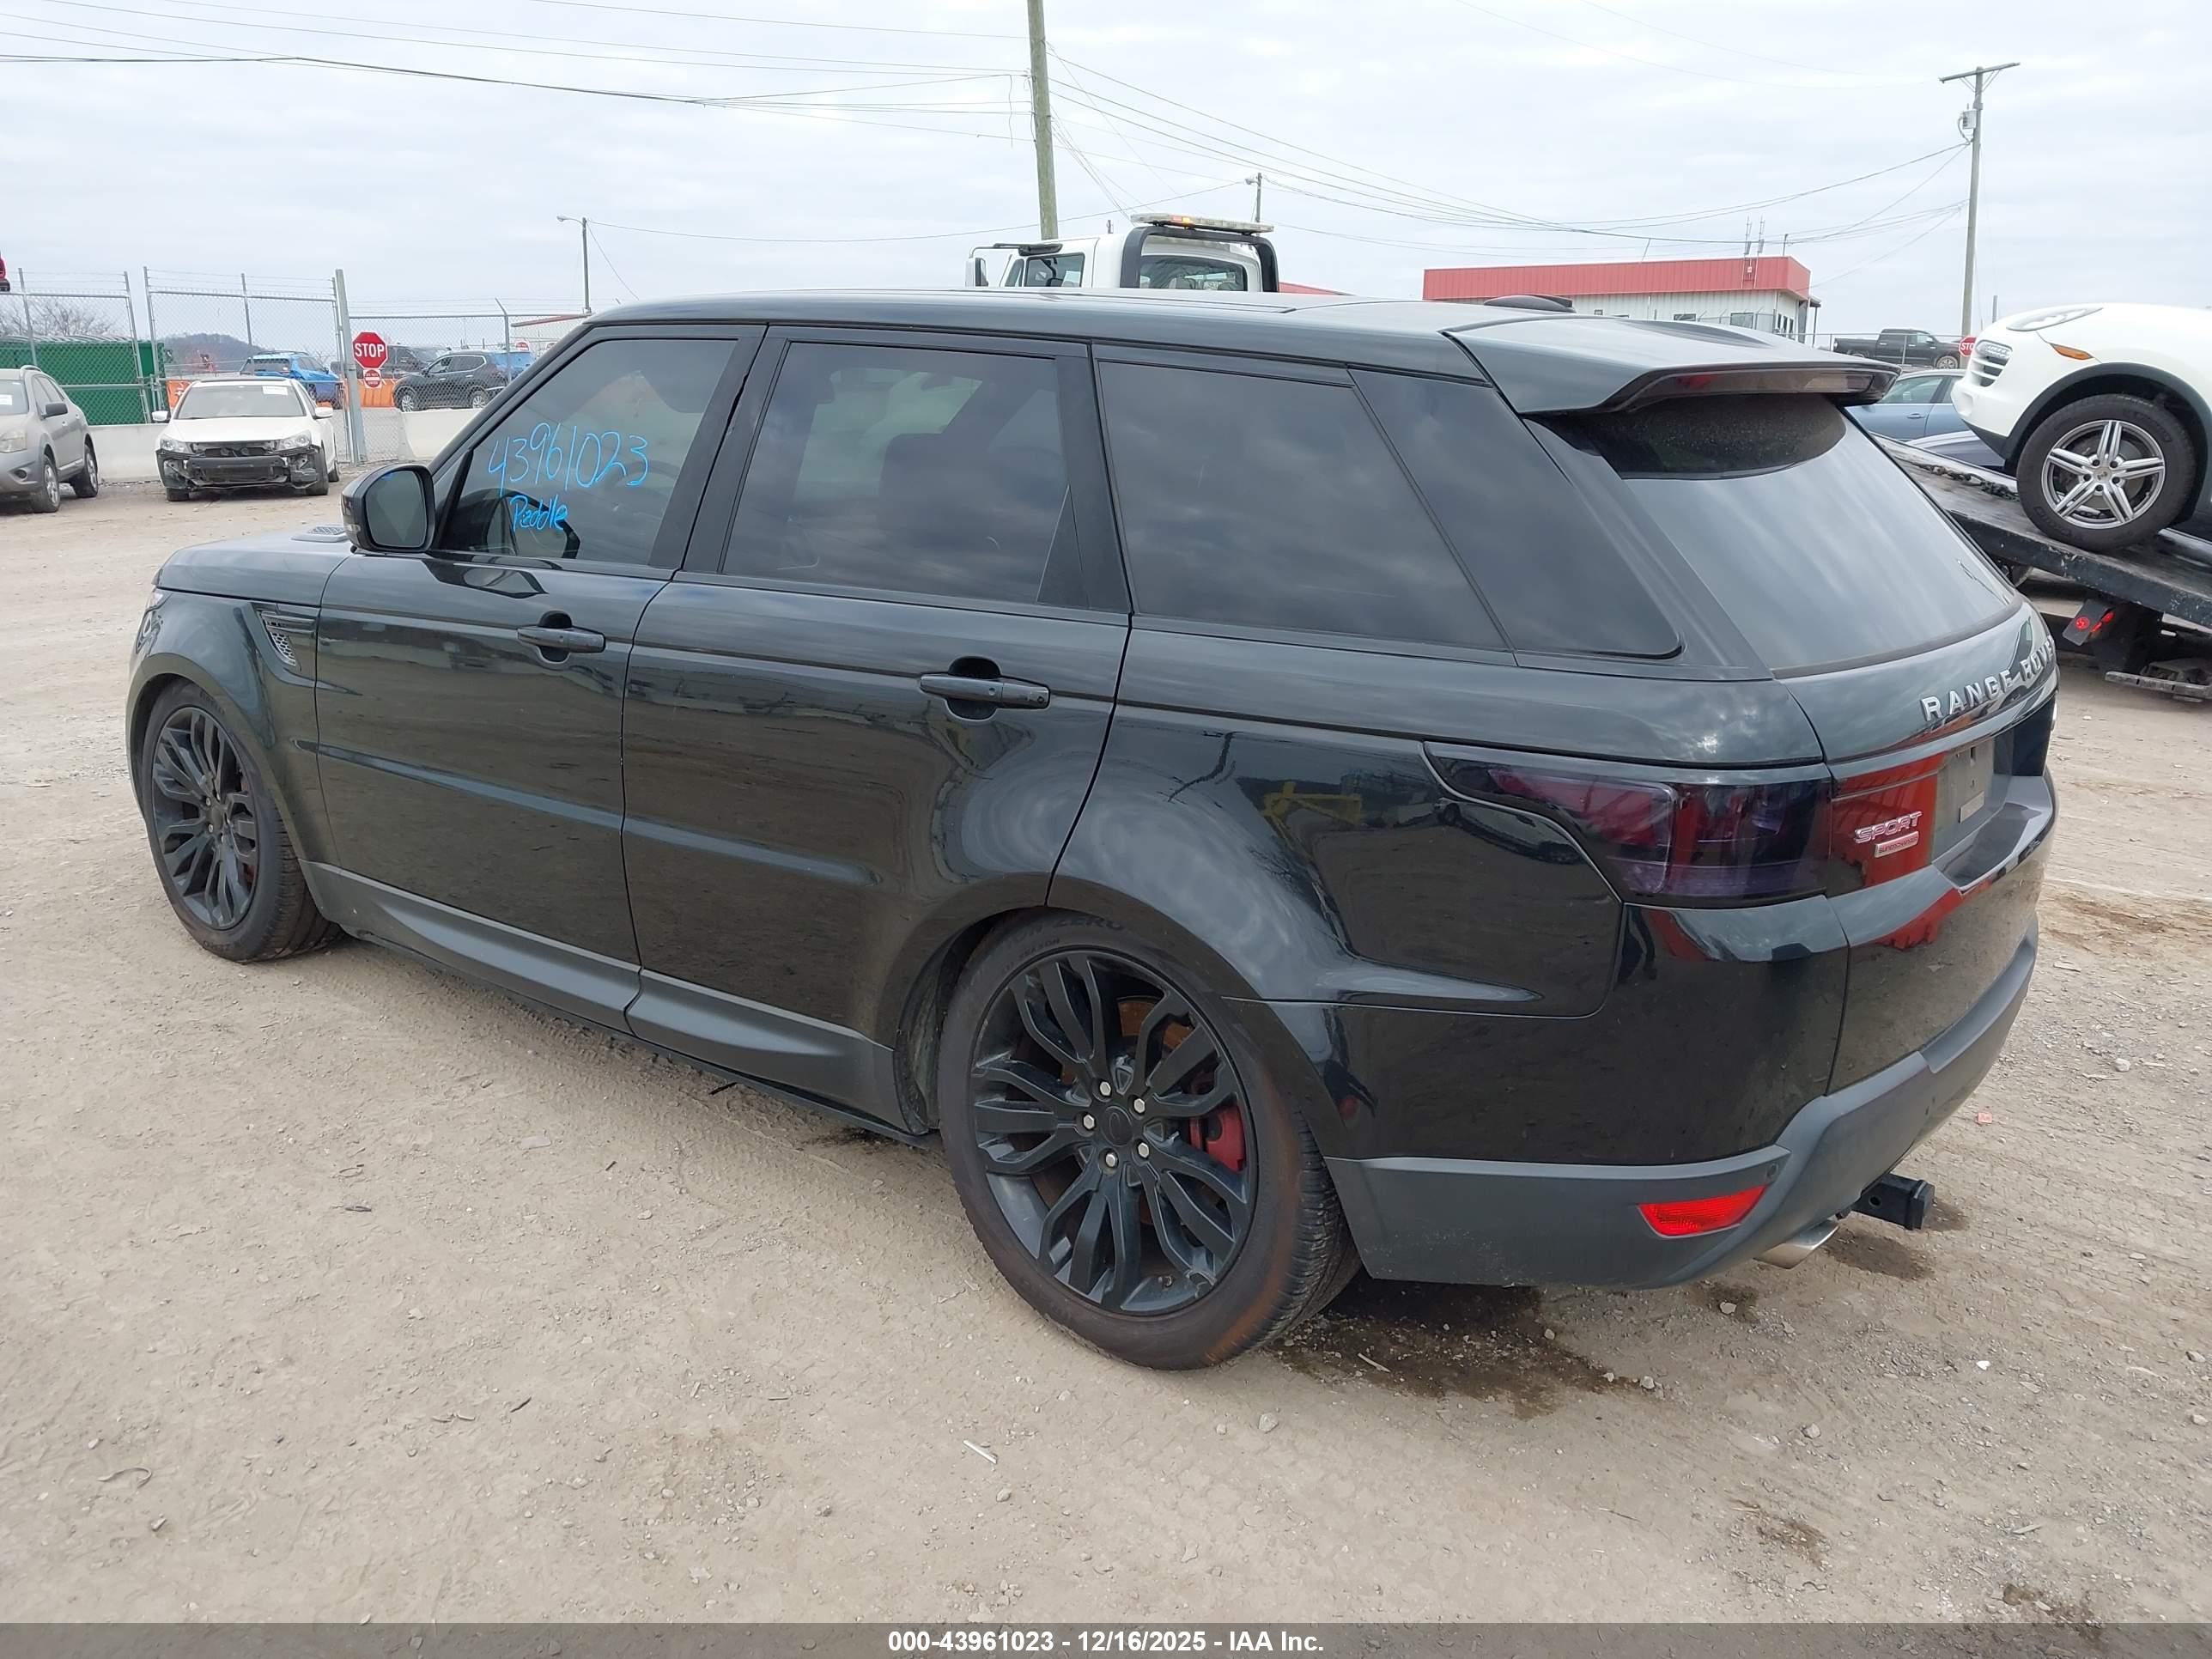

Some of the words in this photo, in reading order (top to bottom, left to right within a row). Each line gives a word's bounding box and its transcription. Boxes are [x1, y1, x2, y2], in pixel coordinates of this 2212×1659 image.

[355, 343, 385, 358] STOP
[1961, 343, 1974, 351] STO
[488, 422, 648, 497] 43961023
[1920, 670, 2014, 721] RANGE
[2020, 635, 2056, 682] ROVE
[1855, 811, 1923, 843] SPORT
